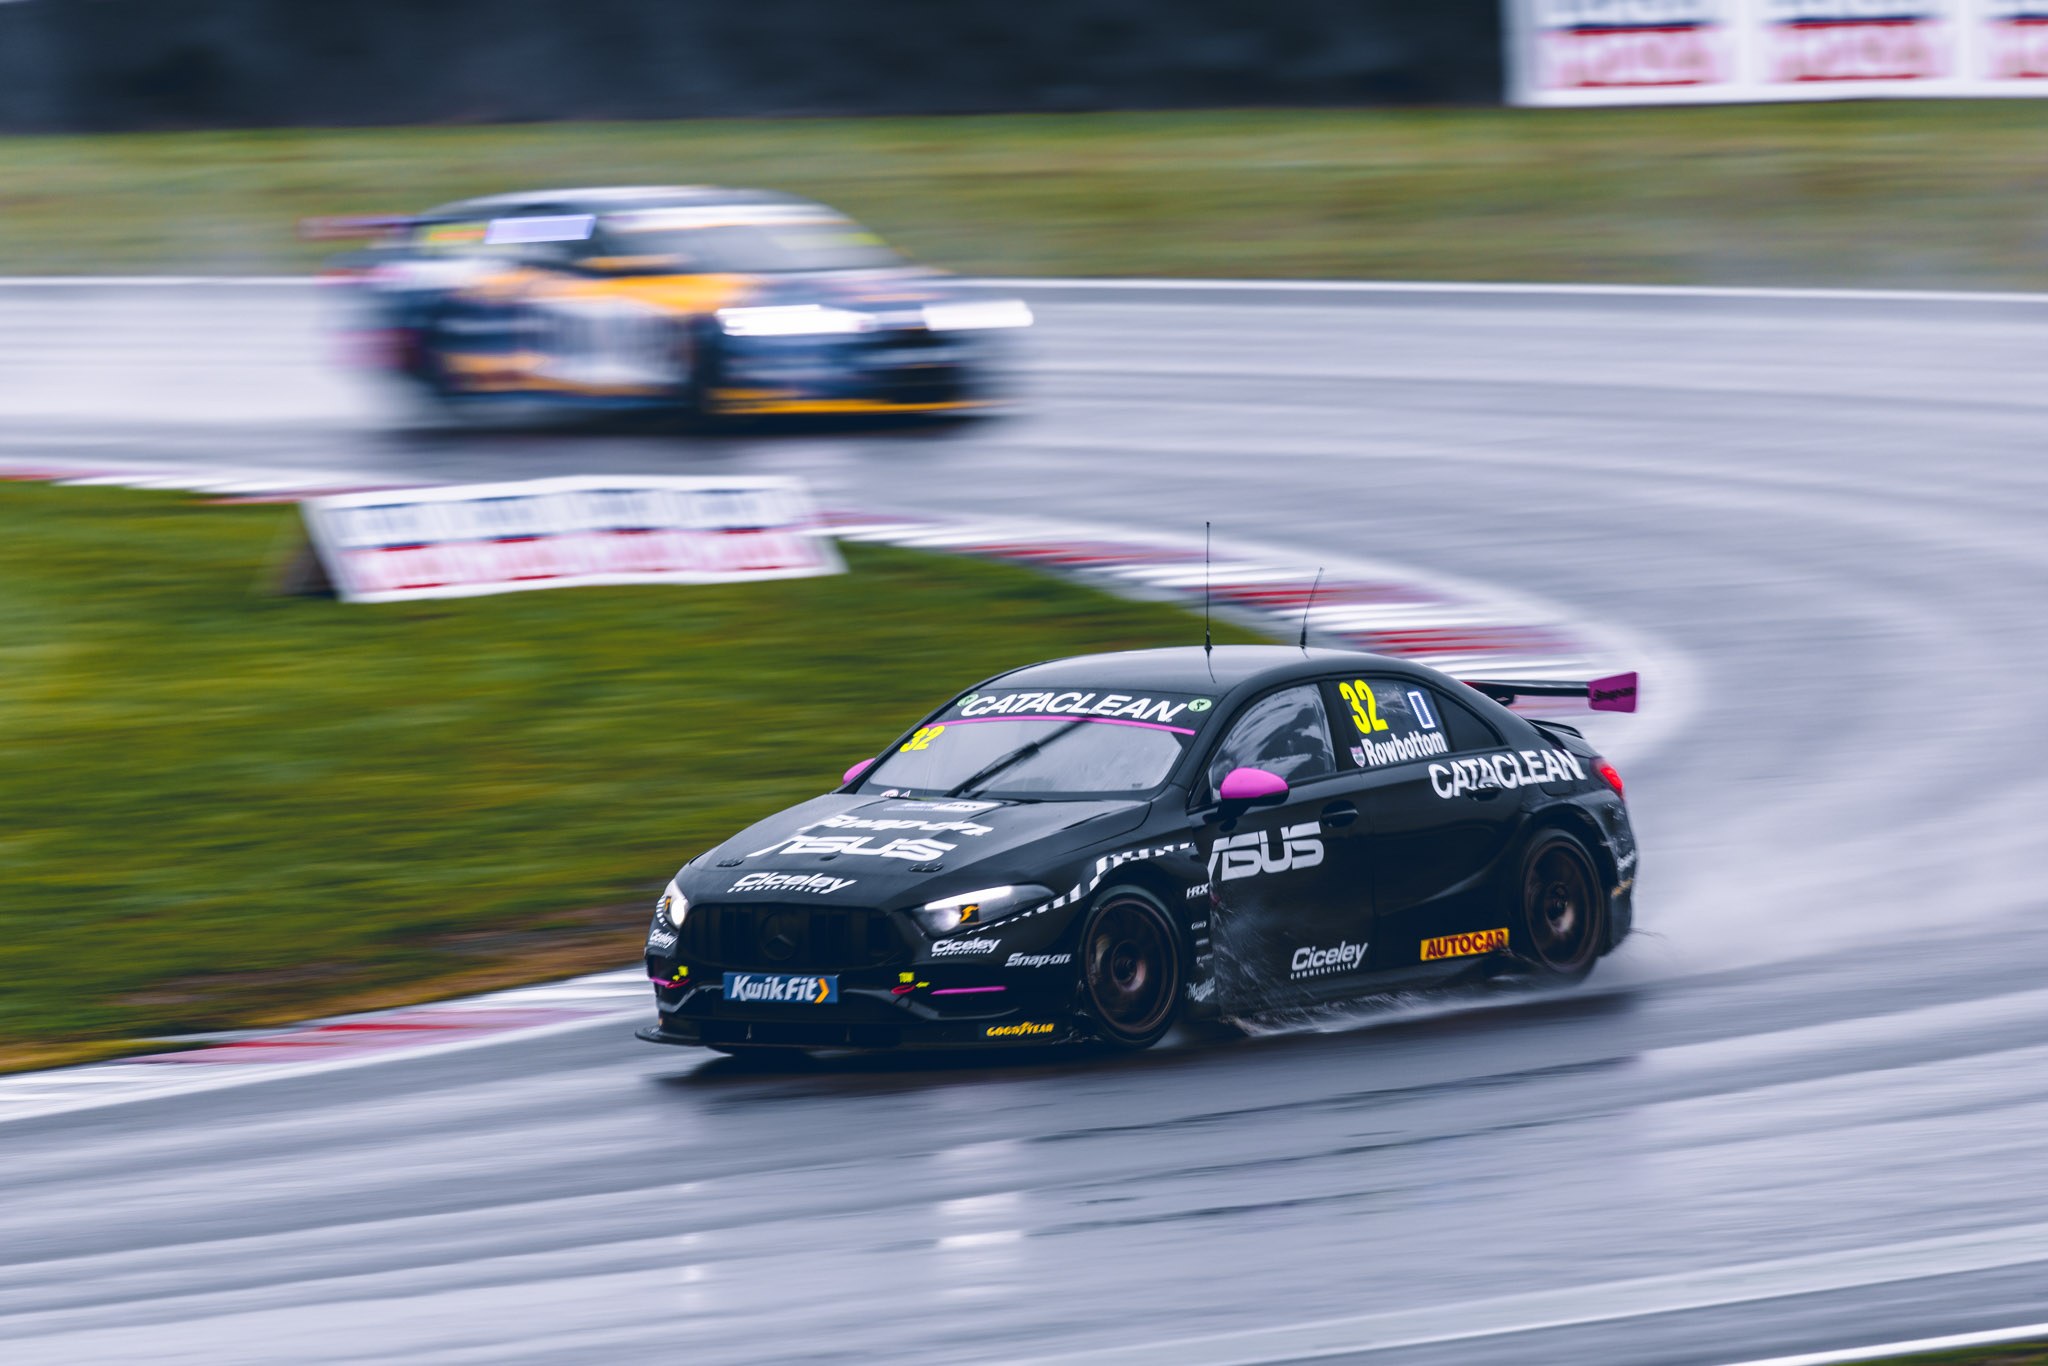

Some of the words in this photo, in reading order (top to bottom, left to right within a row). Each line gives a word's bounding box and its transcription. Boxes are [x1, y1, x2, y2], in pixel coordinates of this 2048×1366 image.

[961, 692, 1187, 722] CATACLEAN
[1339, 679, 1389, 734] 32
[900, 725, 945, 752] 32
[1361, 731, 1448, 766] Rowbottom
[1428, 748, 1588, 799] CATACLEAN
[746, 834, 958, 861] ASUS
[1207, 821, 1324, 881] ASUS
[733, 872, 857, 894] Ciceley
[1186, 883, 1209, 899] HRX
[932, 937, 1001, 953] Ciceley
[1292, 940, 1368, 970] Ciceley
[1426, 930, 1505, 958] AUTOCAR
[1005, 953, 1071, 968] Snap-on
[986, 1021, 1055, 1036] GOODYEAR
